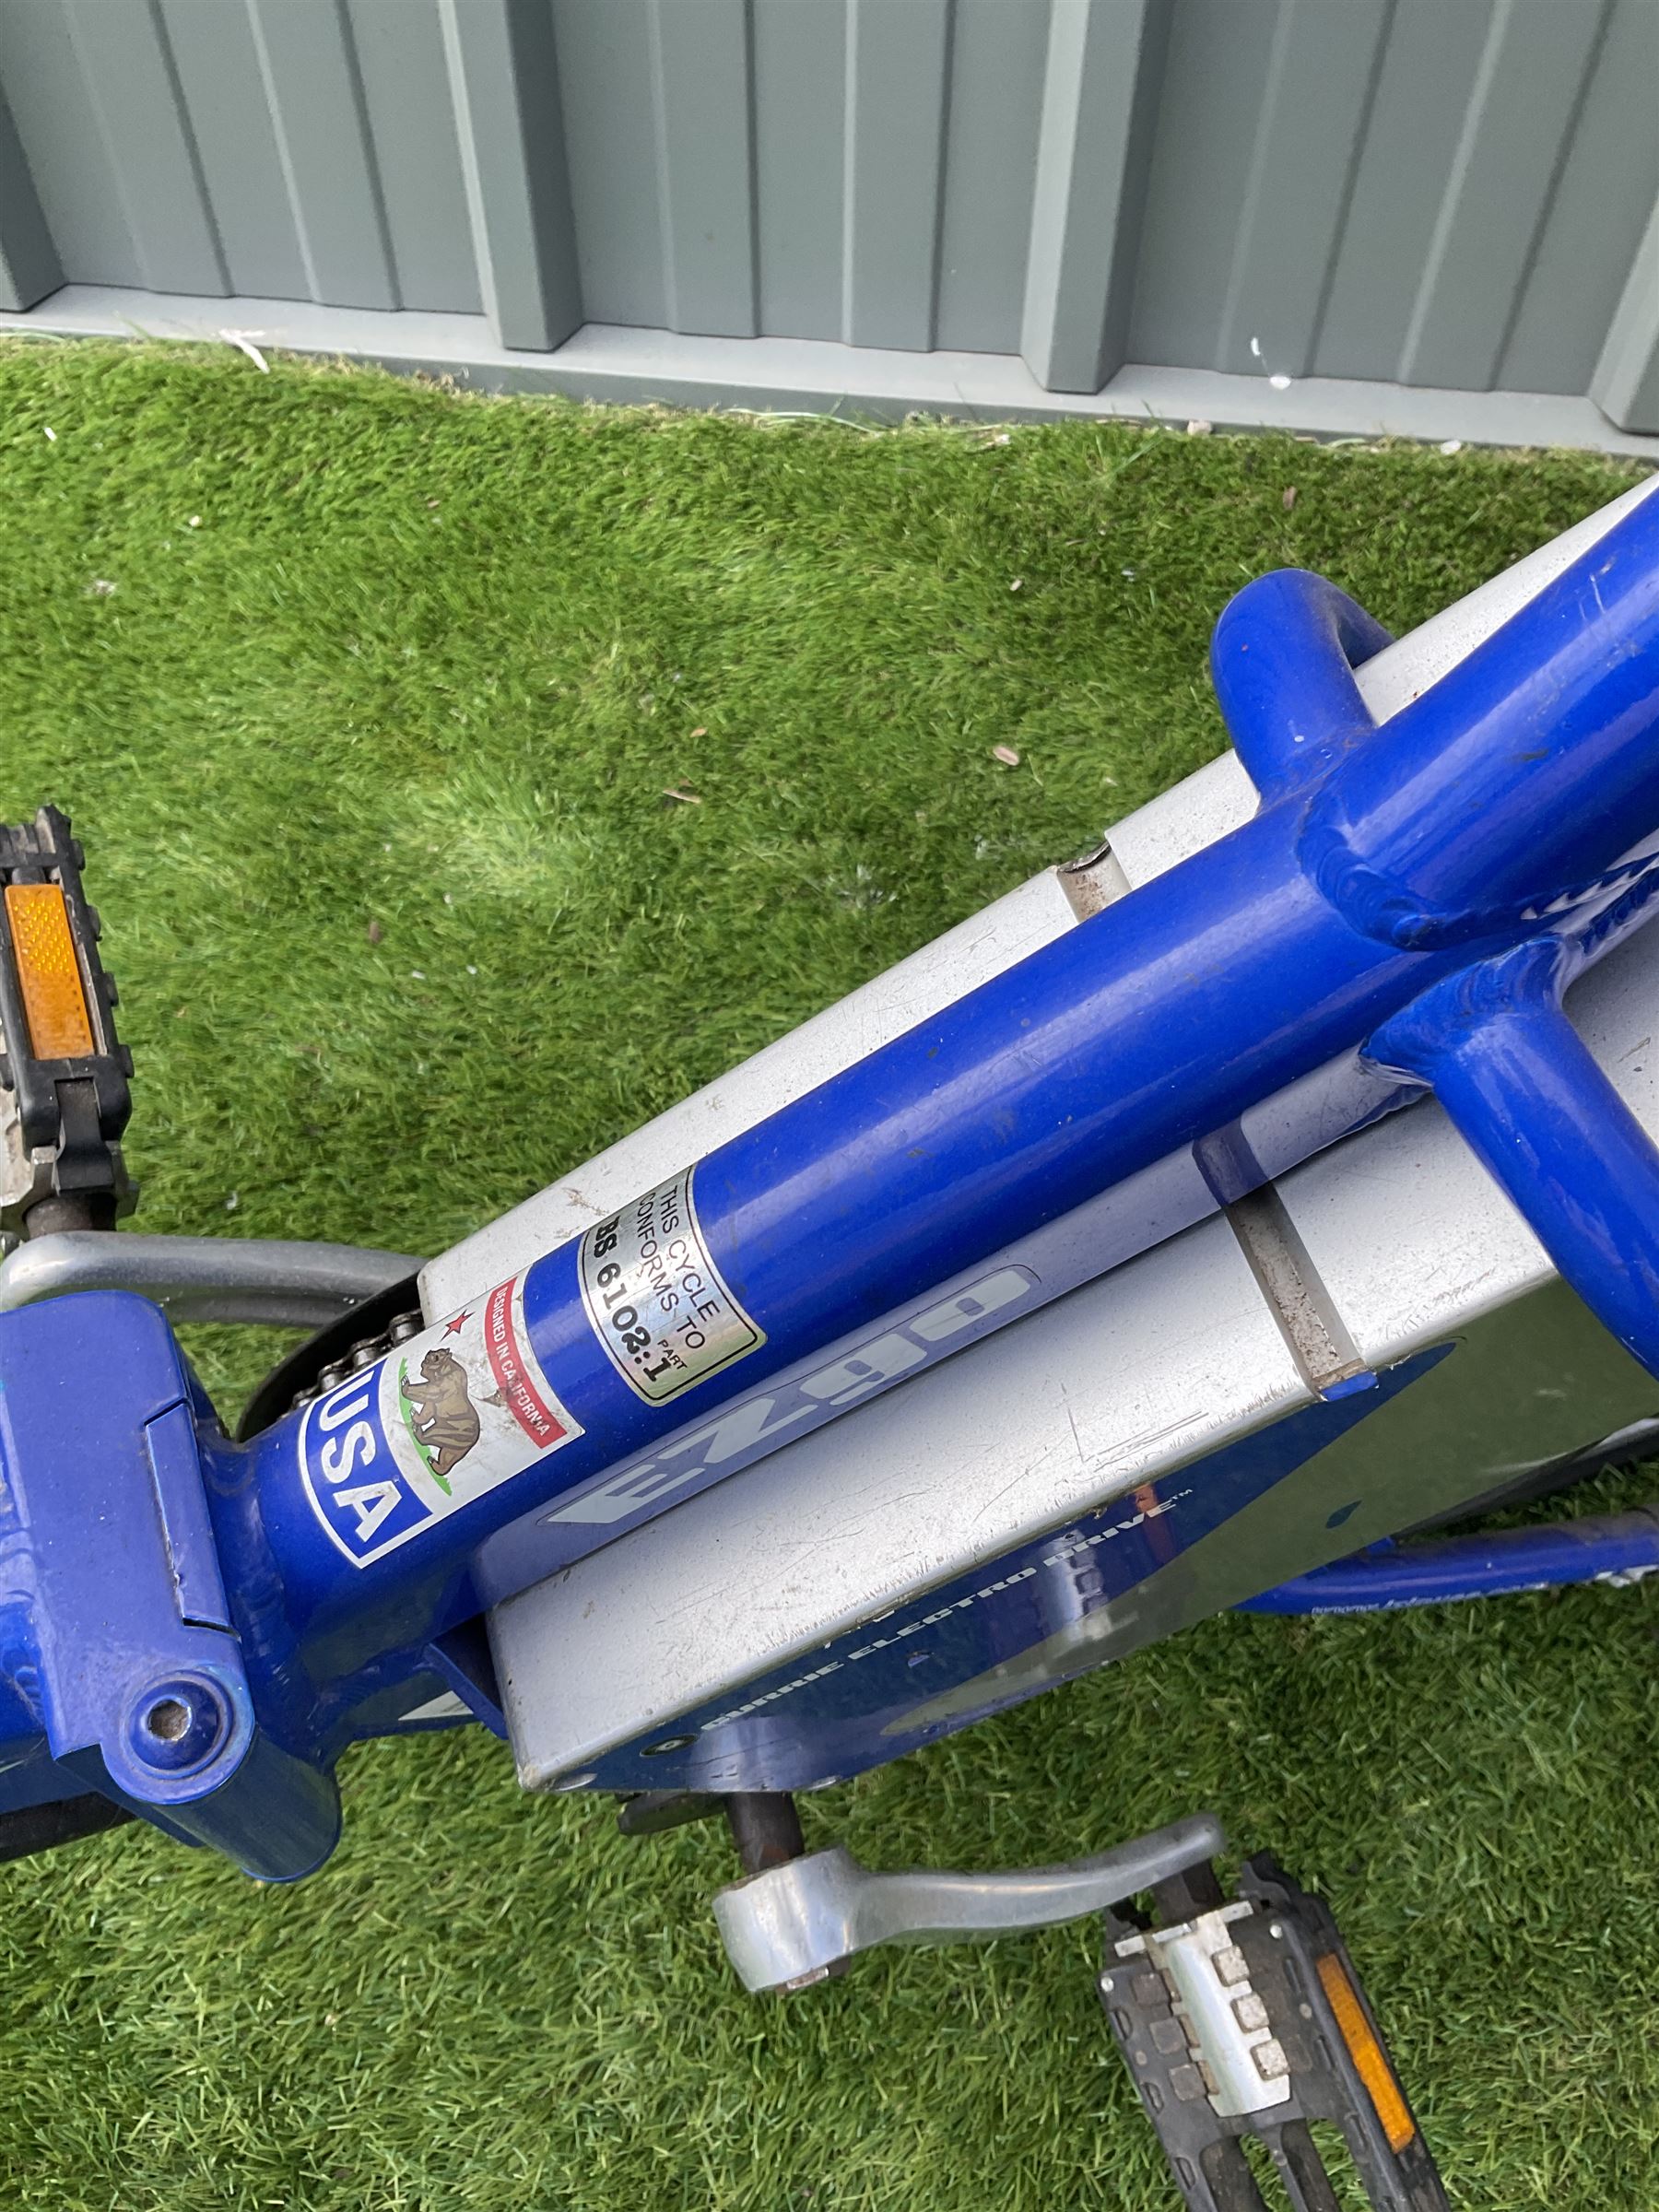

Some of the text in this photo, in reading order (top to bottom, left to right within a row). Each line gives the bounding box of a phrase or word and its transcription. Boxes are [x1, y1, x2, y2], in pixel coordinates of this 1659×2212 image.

[491, 1286, 509, 1343] DESIGNED
[593, 1215, 672, 1382] BS 6102:1
[637, 1192, 706, 1349] CONFORMS TO
[660, 1184, 721, 1323] THIS CYCLE
[496, 1342, 511, 1360] IN
[657, 1338, 688, 1371] PART
[319, 1370, 403, 1544] USA
[700, 1661, 845, 1732] CURRIE
[847, 1567, 1037, 1660] ELECTRO
